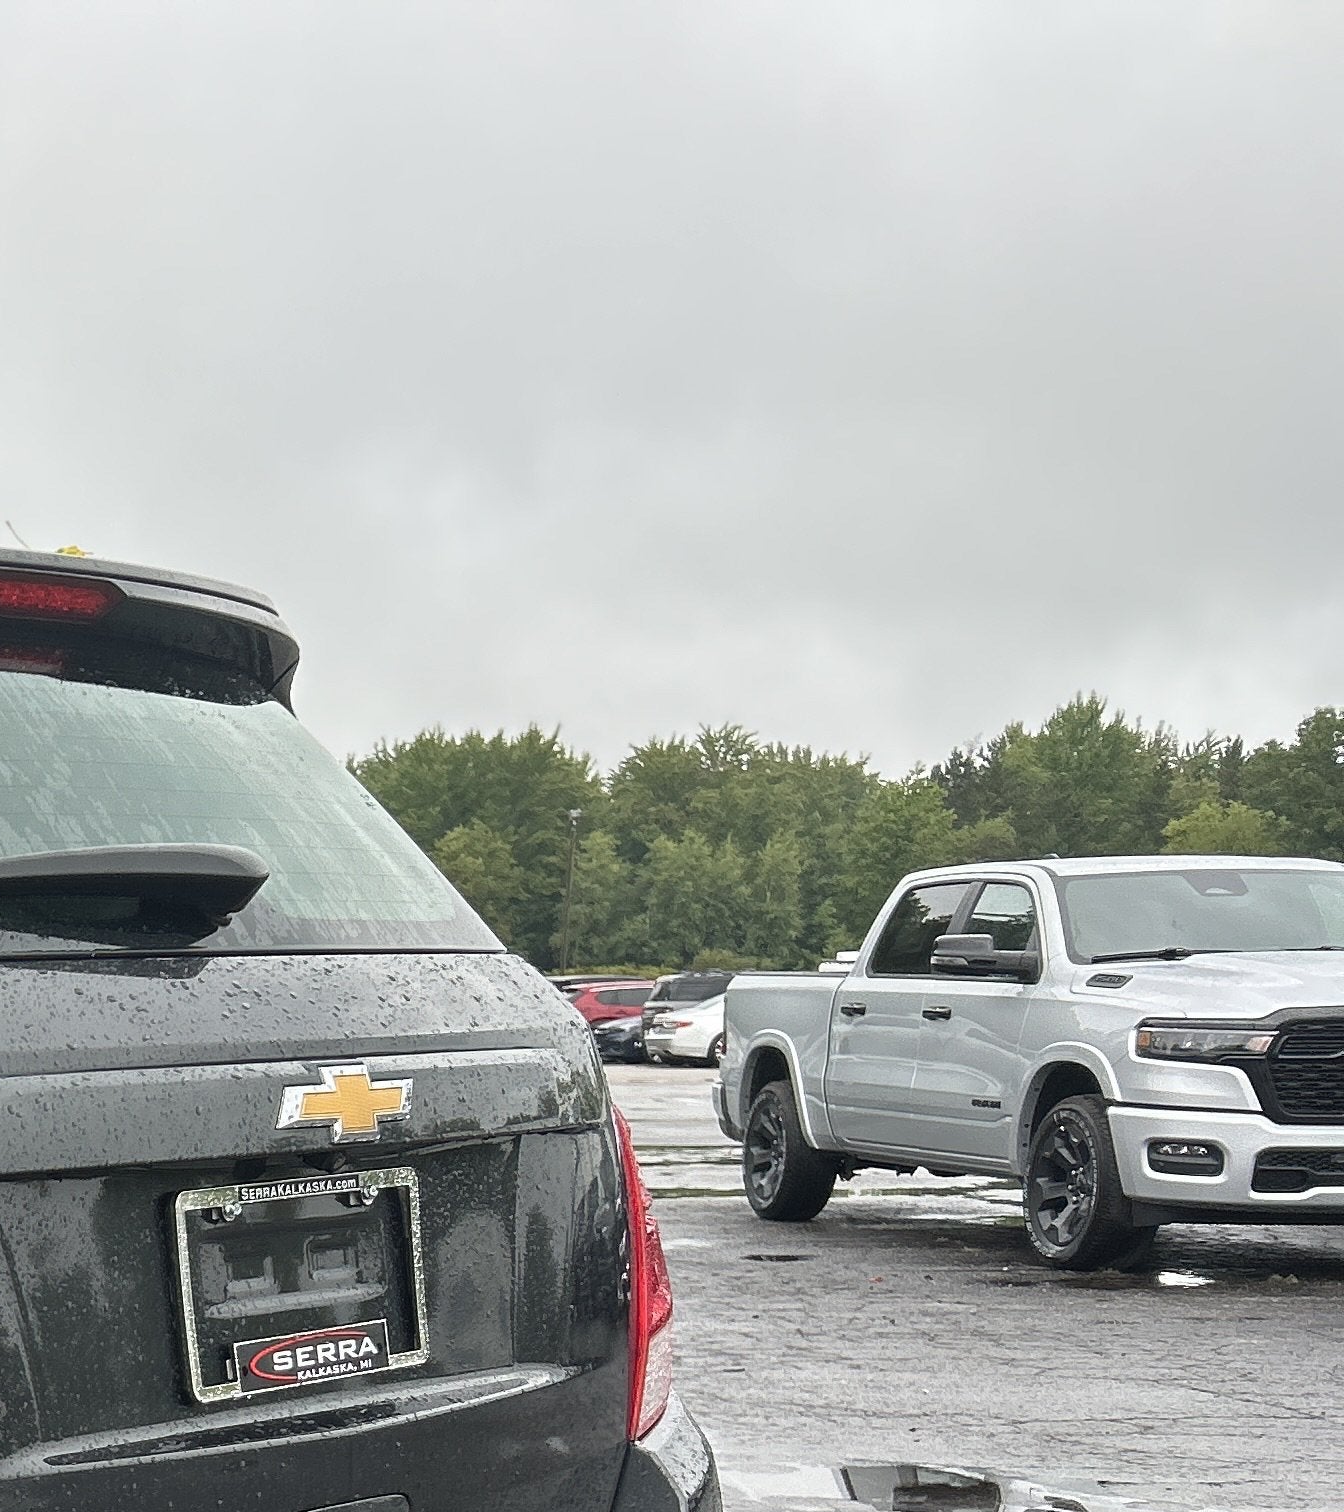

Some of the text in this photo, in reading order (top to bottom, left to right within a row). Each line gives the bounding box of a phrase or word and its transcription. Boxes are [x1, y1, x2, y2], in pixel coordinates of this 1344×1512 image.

[241, 1179, 357, 1200] SERRAKALKASKA.com
[272, 1336, 379, 1371] SERRA
[296, 1358, 372, 1380] KALKASKA, MI
